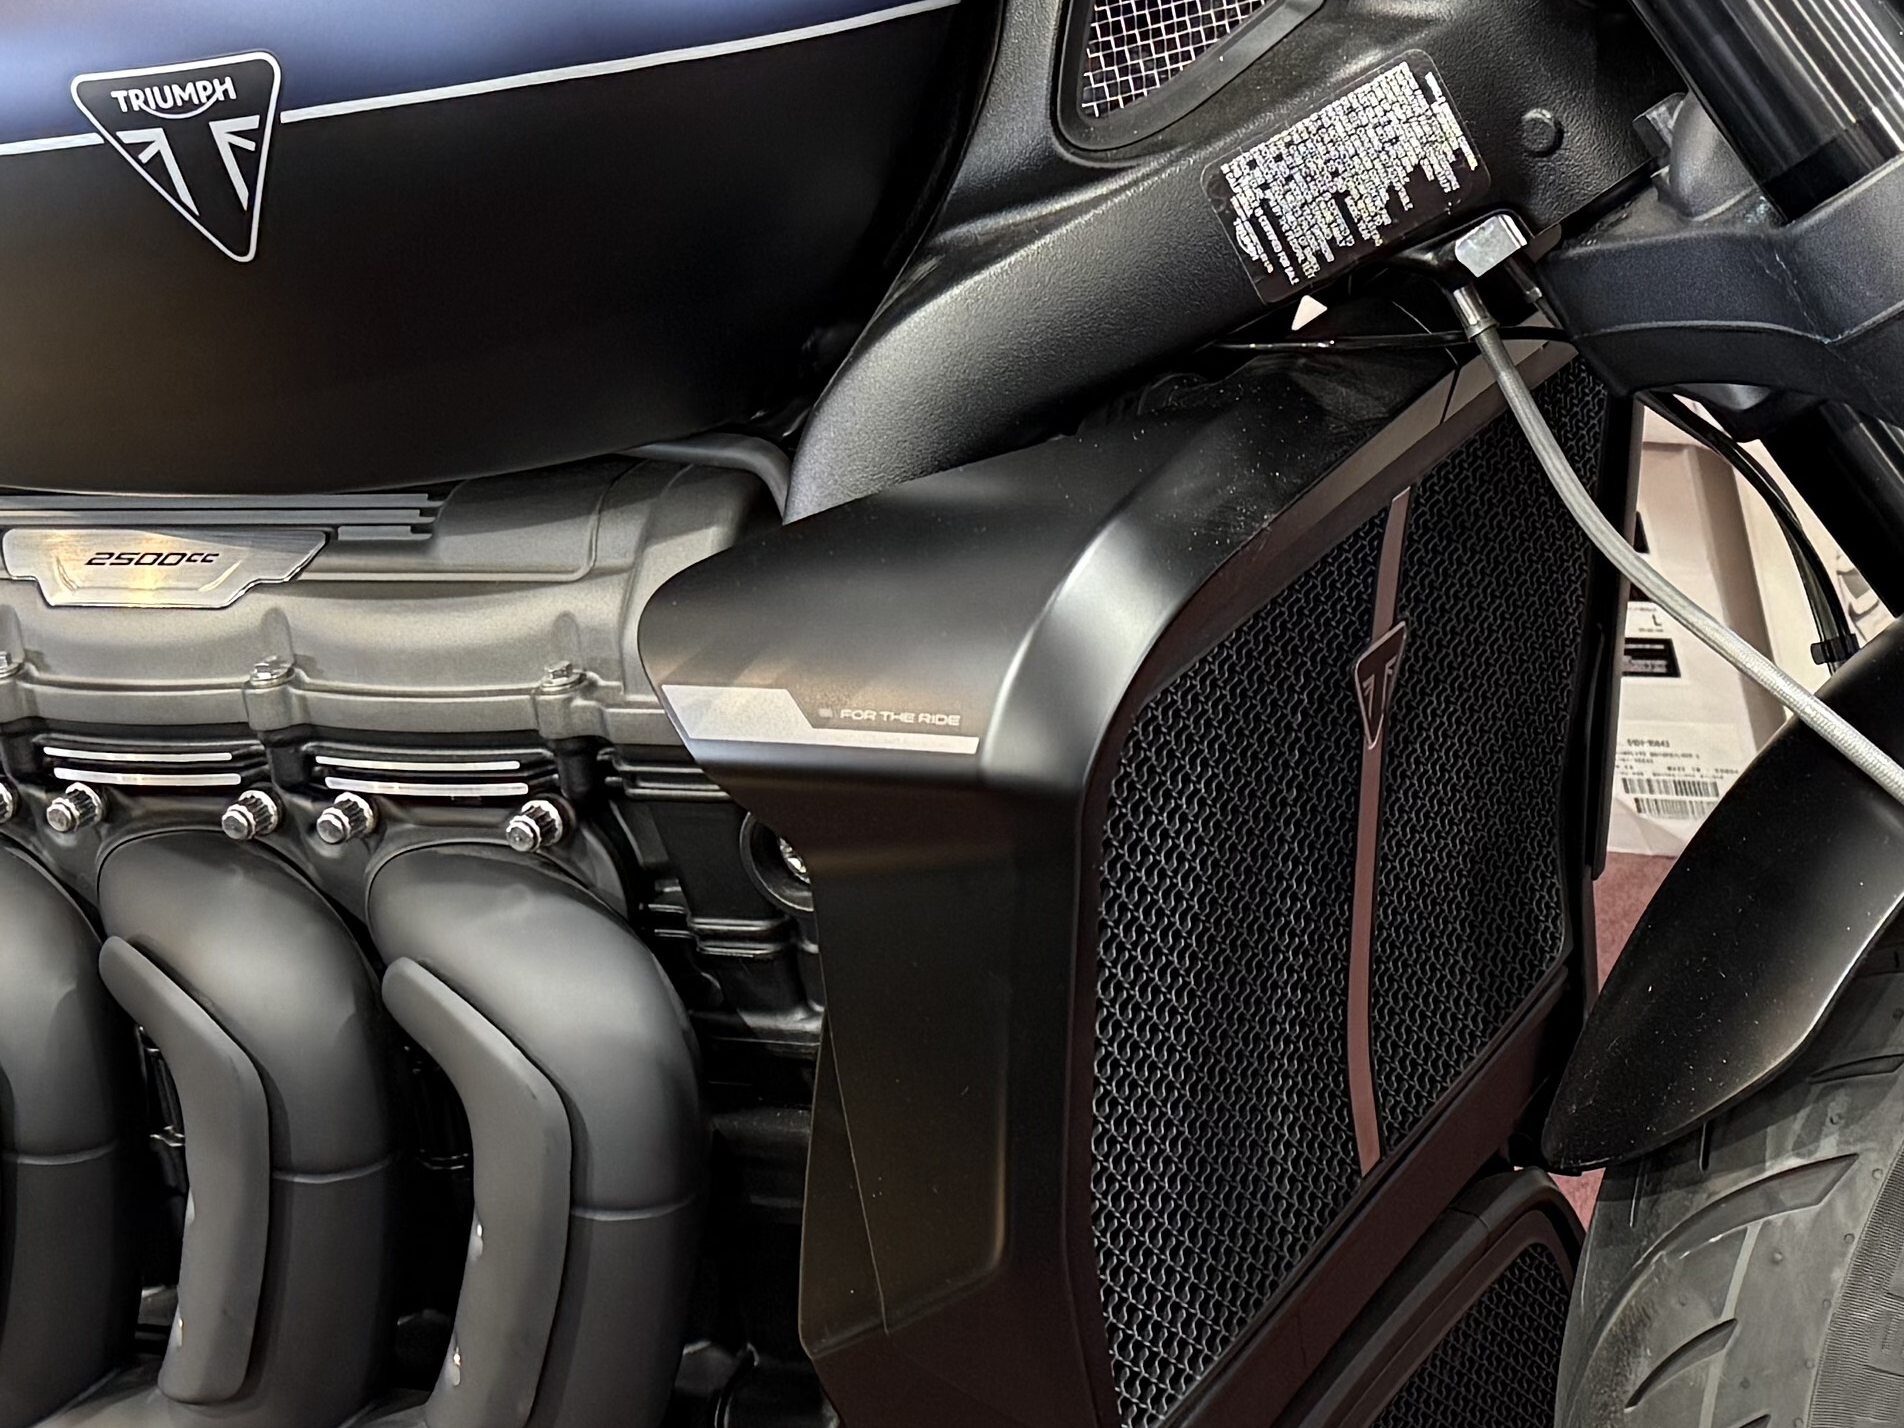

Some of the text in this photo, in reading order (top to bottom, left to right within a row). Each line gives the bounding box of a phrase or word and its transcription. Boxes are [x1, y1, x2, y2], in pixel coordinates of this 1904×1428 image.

[110, 74, 240, 119] TRIUMPH
[83, 547, 220, 569] 2500cc
[840, 708, 962, 727] FOR THE RIDE
